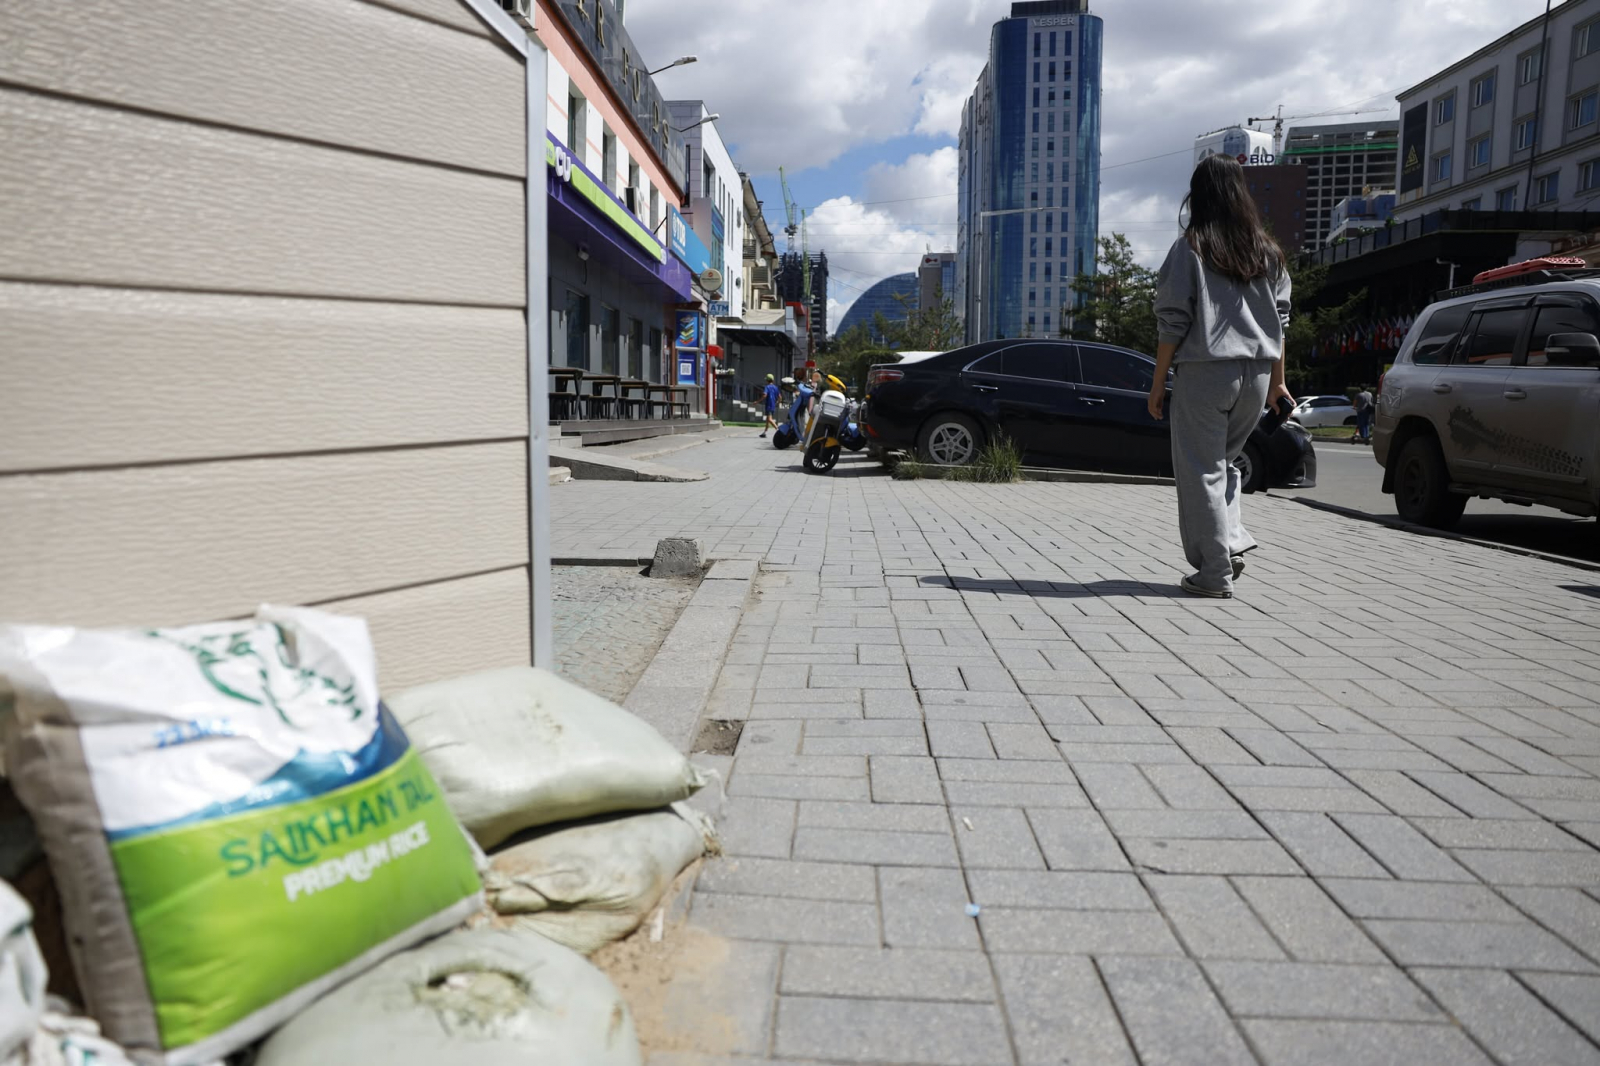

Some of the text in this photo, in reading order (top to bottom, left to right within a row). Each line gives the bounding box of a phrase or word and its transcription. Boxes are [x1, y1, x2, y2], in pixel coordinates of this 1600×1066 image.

[556, 146, 571, 182] CU
[710, 304, 729, 312] ATM
[220, 789, 399, 878] SAIKHAN
[282, 820, 431, 902] PREMIUM RICE
